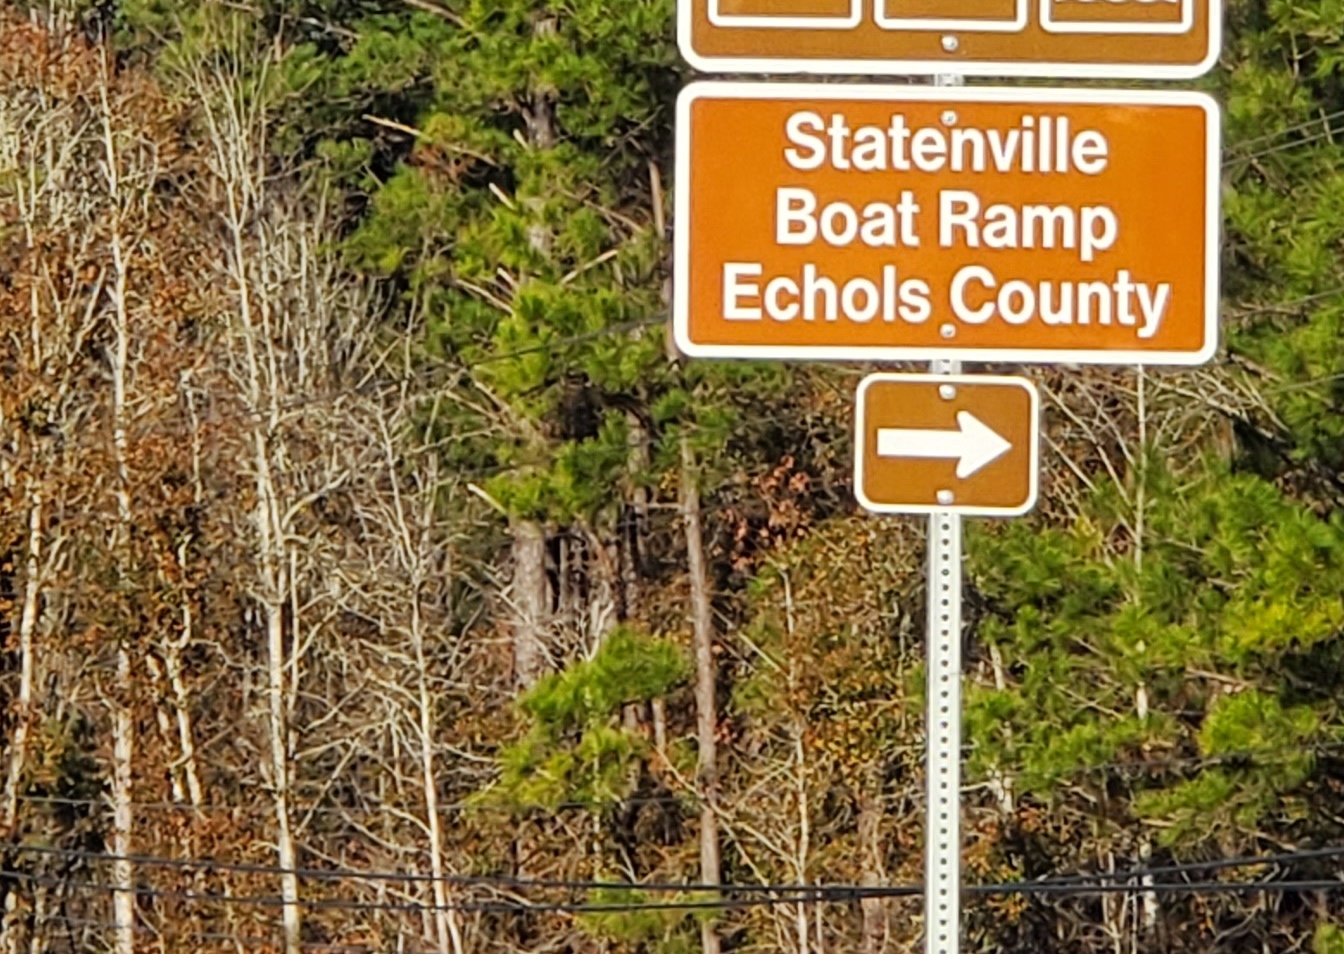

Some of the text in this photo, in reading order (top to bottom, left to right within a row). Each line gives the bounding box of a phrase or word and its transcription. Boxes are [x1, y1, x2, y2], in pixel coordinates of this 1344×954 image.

[784, 111, 1109, 175] Statenville
[776, 187, 1118, 262] Boat Ramp
[722, 262, 1171, 339] Echols County
